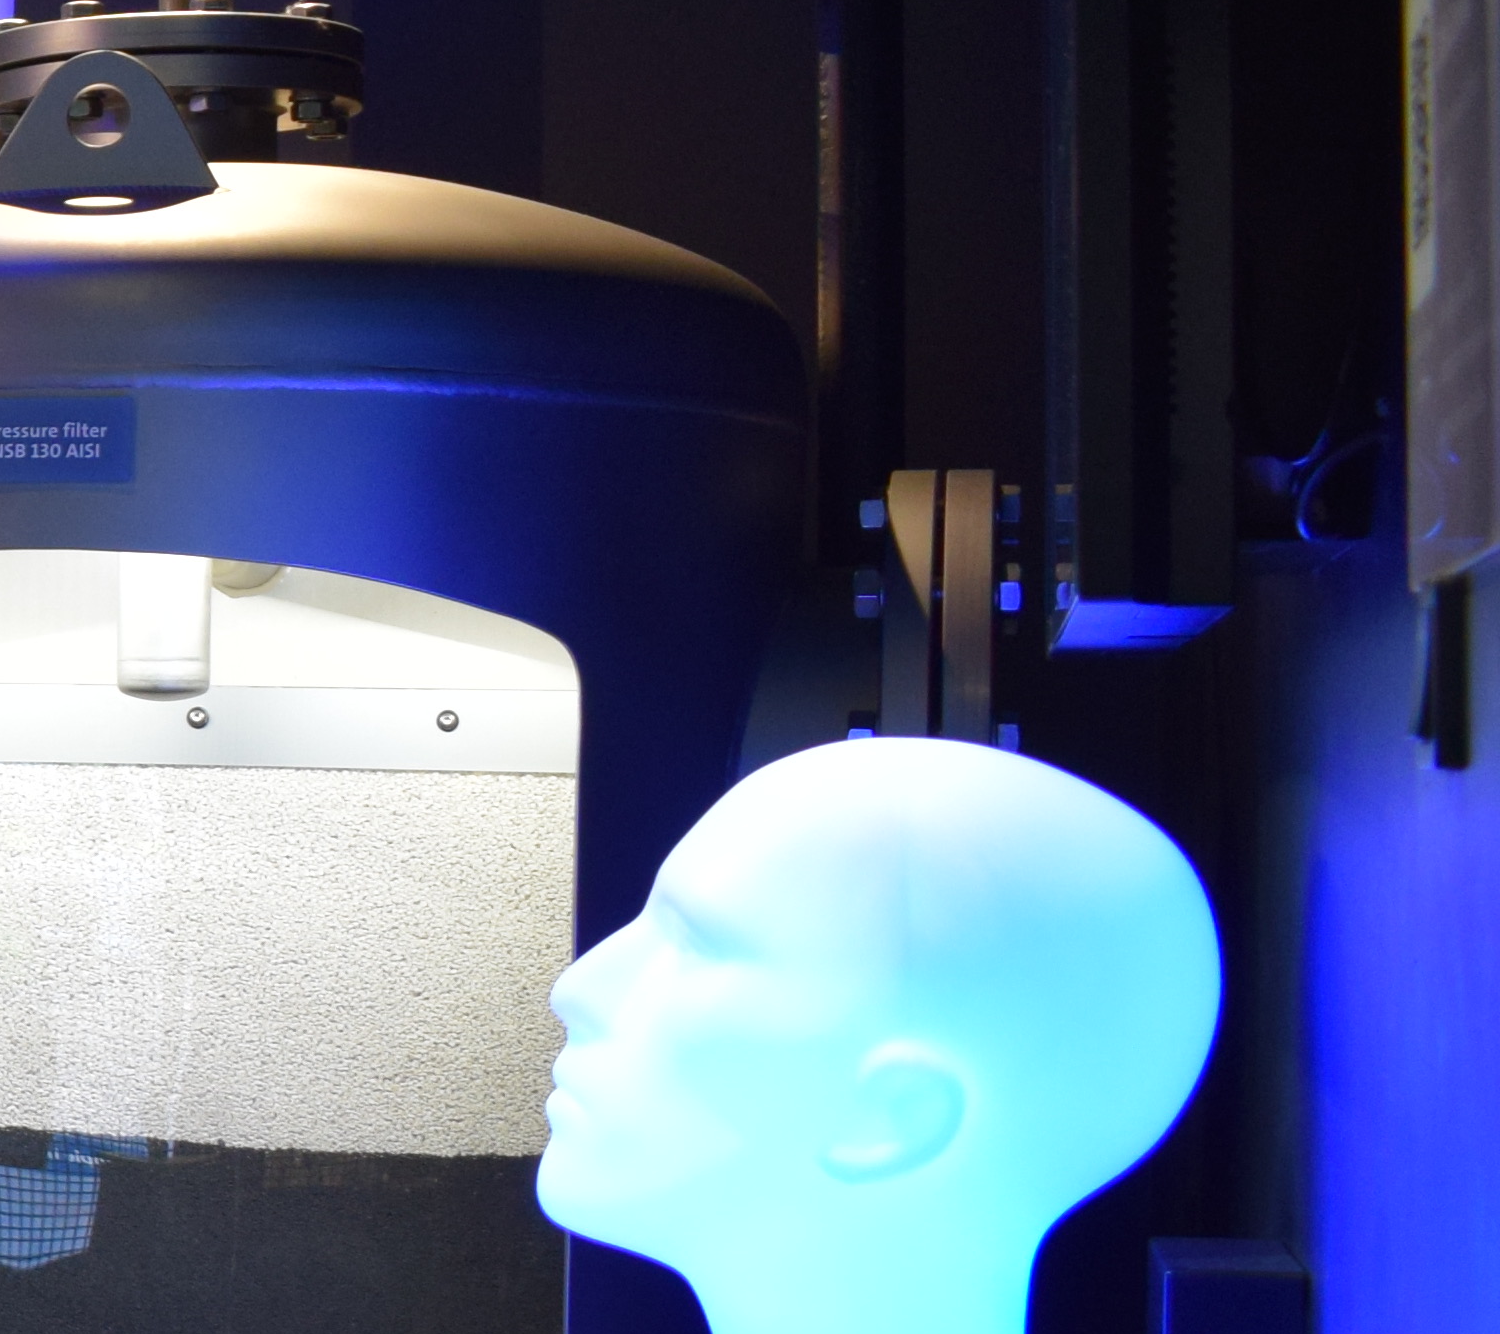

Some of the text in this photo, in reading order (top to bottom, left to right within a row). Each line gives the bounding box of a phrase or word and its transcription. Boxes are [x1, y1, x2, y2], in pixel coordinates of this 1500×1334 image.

[63, 422, 108, 438] filter
[30, 443, 62, 458] 130
[65, 443, 101, 458] AISI
